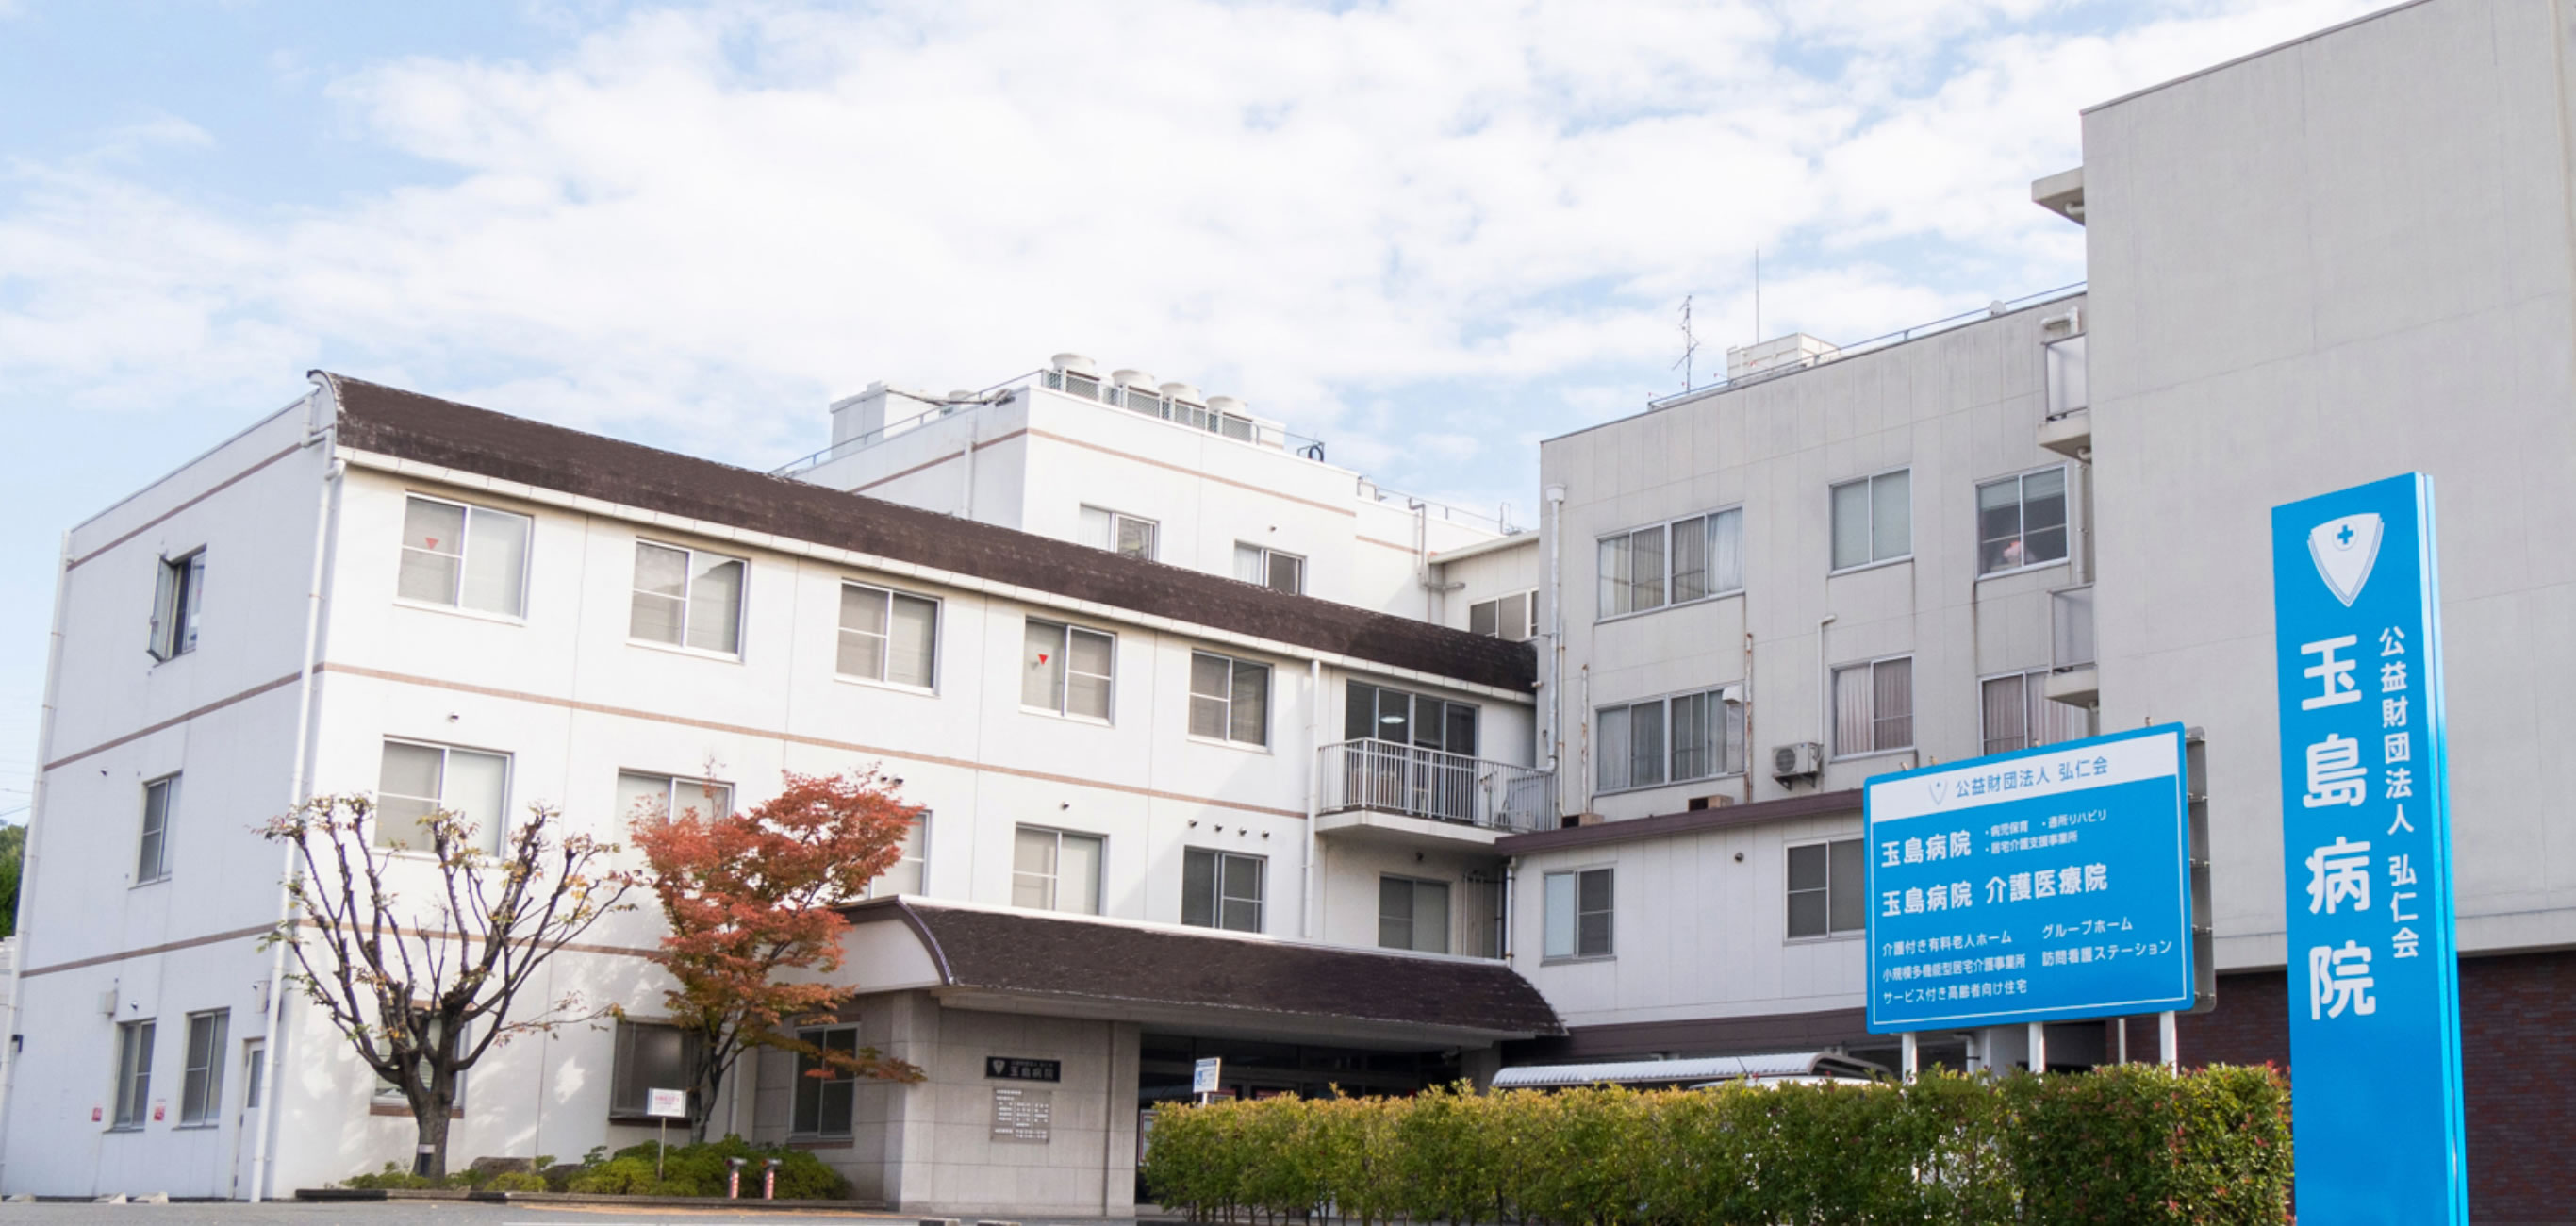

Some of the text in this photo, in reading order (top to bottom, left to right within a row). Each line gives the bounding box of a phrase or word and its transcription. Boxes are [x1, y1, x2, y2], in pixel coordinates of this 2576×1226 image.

[1956, 755, 2108, 798] 公益財団法人 弘仁会
[2379, 625, 2419, 959] 公益財団法人 弘仁会
[2300, 634, 2376, 1020] 玉島病院
[1881, 830, 1972, 868] 玉島病院
[1882, 863, 2107, 917] 玉島病院 介護医療院
[1883, 930, 2012, 956] 介護付き有料老人ホーム
[2042, 917, 2133, 939] グループホーム
[1883, 953, 2026, 982] 小規模多機能型居宅介護事業所
[2041, 940, 2172, 967] 訪問看護ステーション
[1884, 979, 2028, 1004] サービス付き高齢者向け住宅
